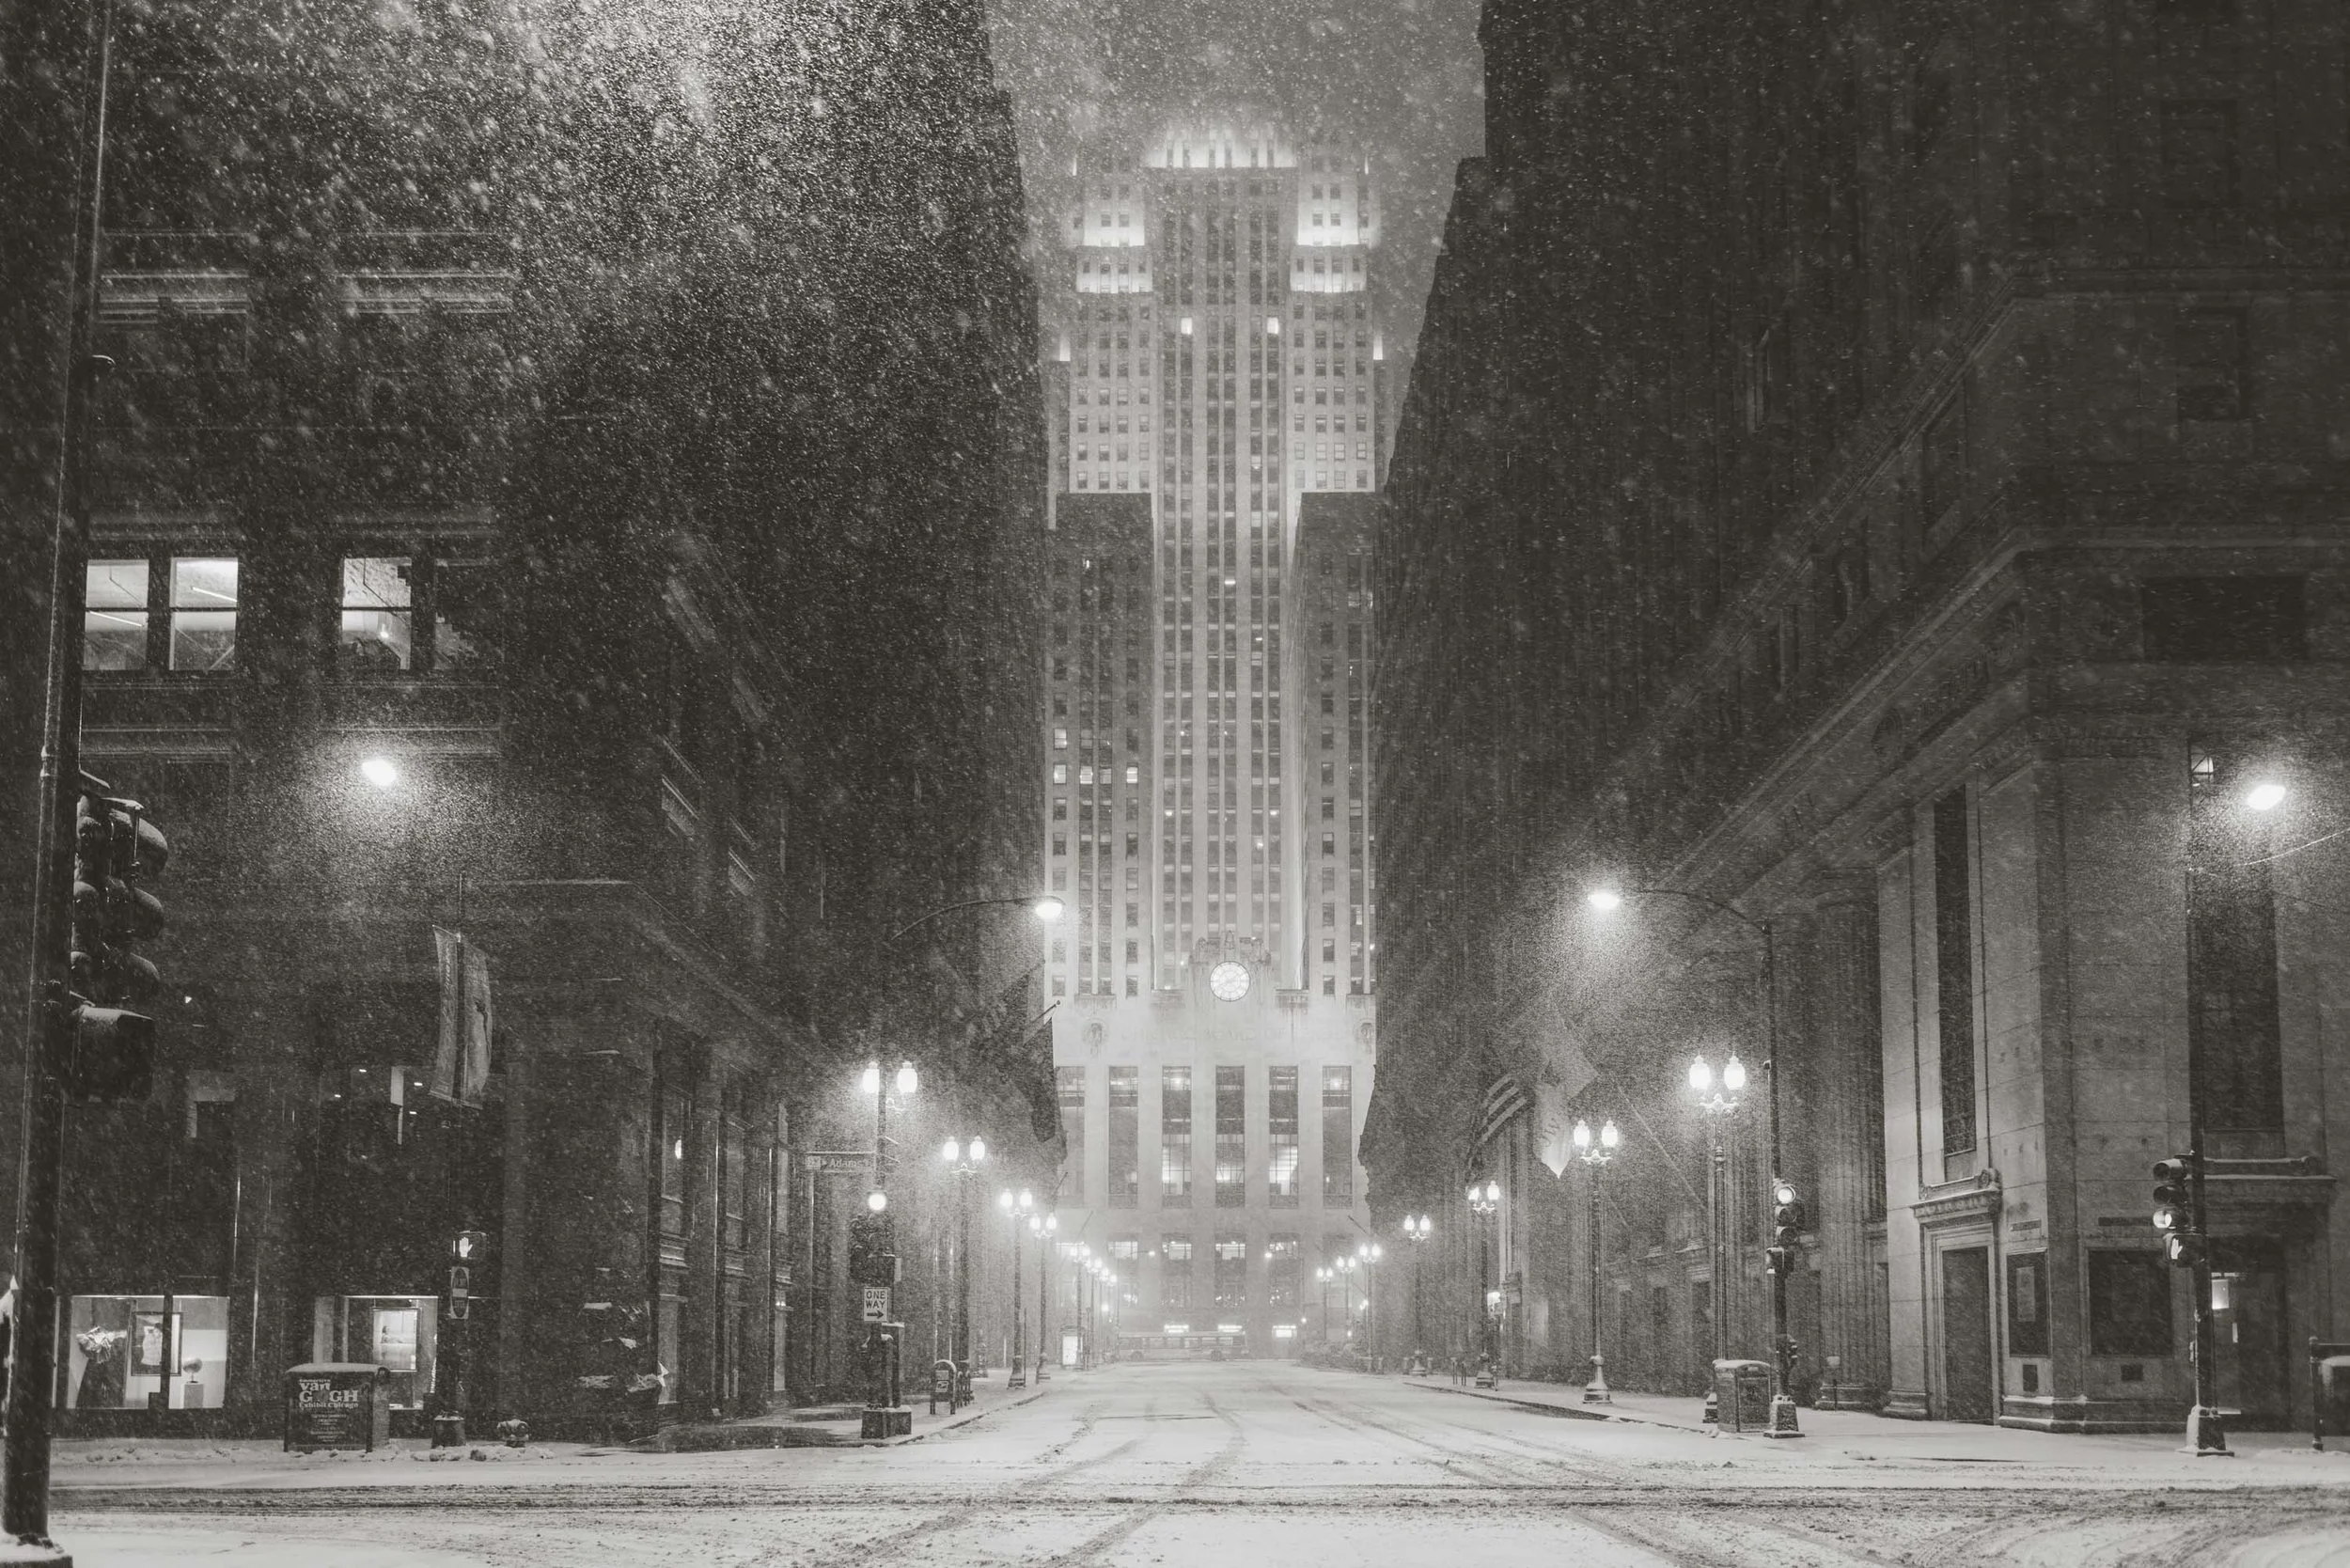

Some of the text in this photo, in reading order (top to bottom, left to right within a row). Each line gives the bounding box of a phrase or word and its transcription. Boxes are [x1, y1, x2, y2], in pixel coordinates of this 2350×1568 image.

[829, 1157, 864, 1167] Adams
[866, 1291, 885, 1299] ONE
[865, 1300, 885, 1309] WAY
[299, 1382, 331, 1391] van
